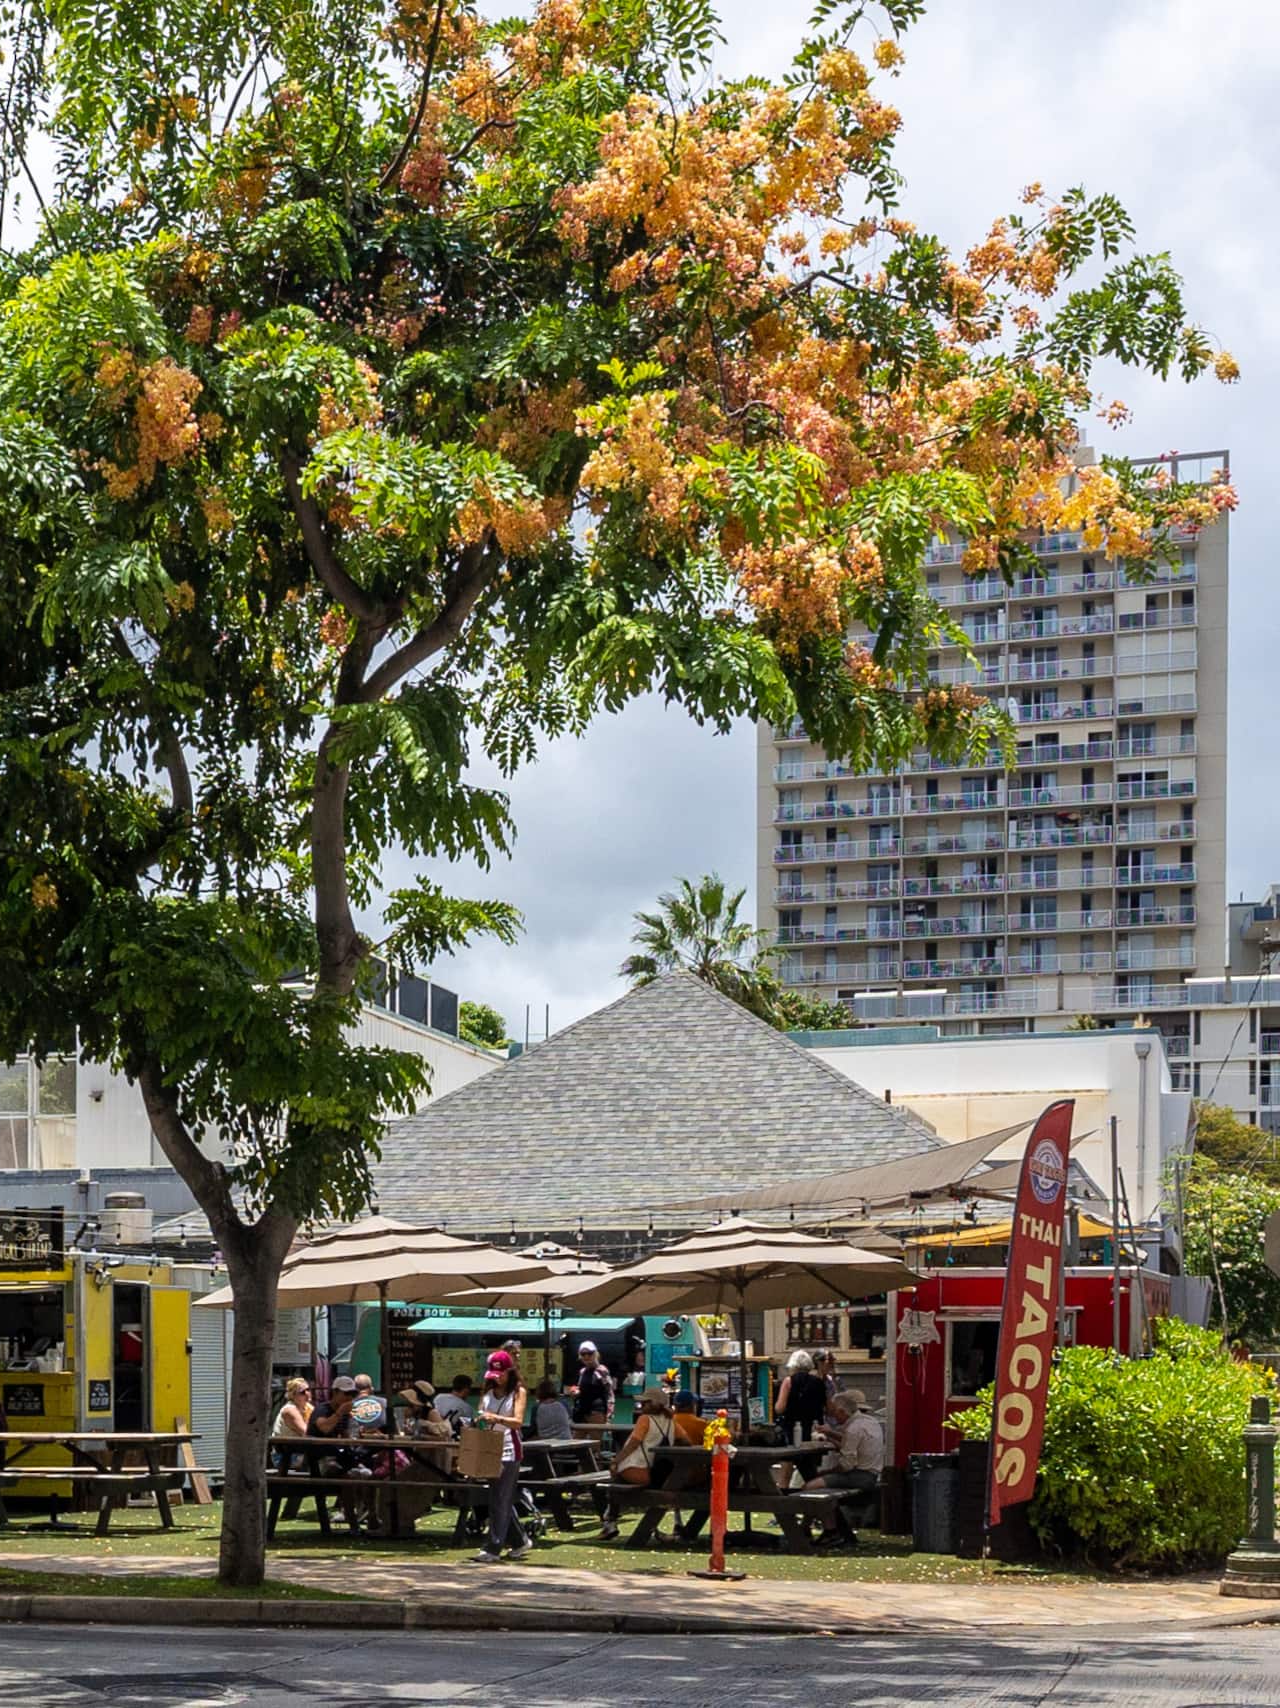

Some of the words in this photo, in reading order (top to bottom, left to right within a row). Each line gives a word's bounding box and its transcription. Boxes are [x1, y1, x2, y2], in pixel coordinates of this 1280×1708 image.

[1020, 1213, 1062, 1248] THAI
[394, 1308, 421, 1318] POKE
[424, 1308, 453, 1318] BOWL
[487, 1308, 520, 1318] FRESH
[994, 1255, 1053, 1487] TACOS
